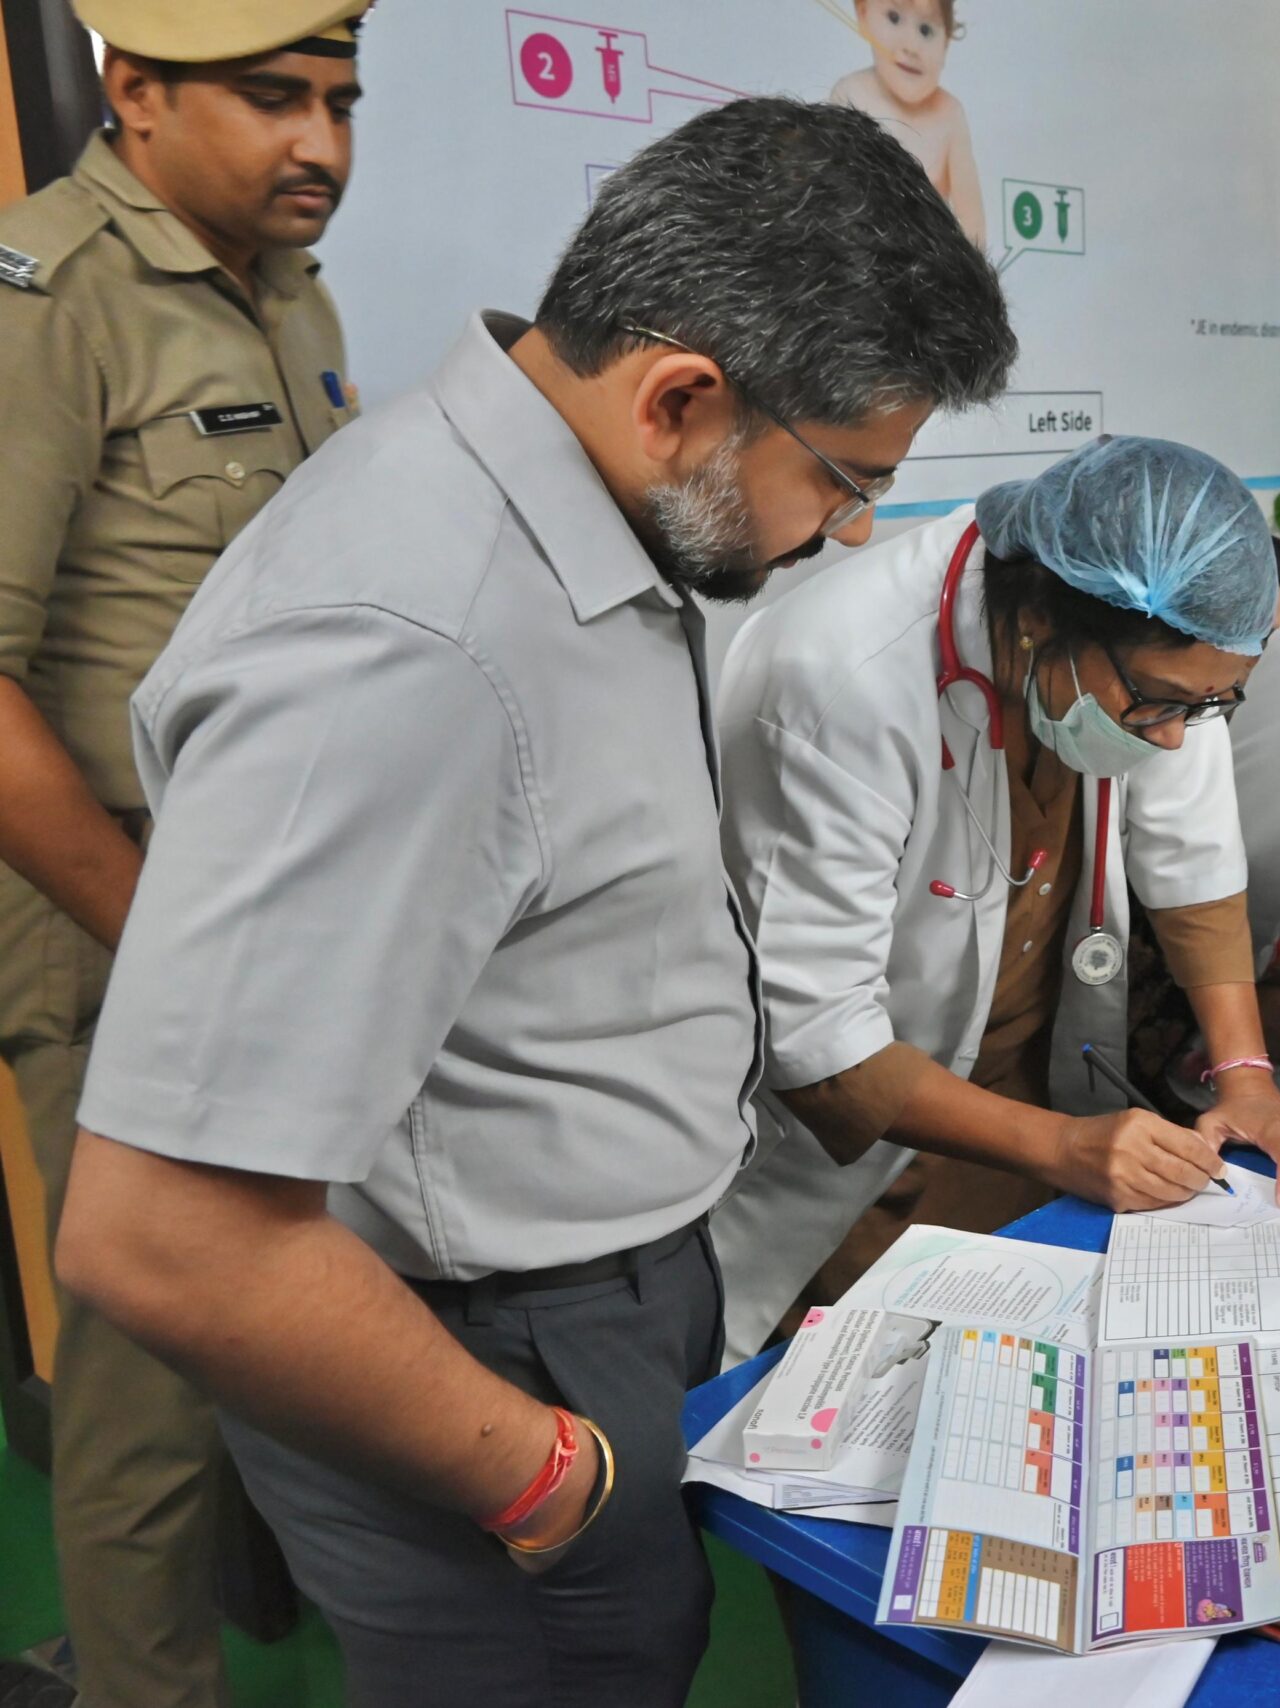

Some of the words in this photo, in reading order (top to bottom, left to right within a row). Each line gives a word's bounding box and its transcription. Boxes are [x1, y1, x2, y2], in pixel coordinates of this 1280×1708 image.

[537, 51, 556, 80] 2
[1022, 205, 1033, 226] 3
[1029, 410, 1056, 433] Left
[1061, 411, 1092, 432] Side
[746, 1409, 767, 1429] sanofi
